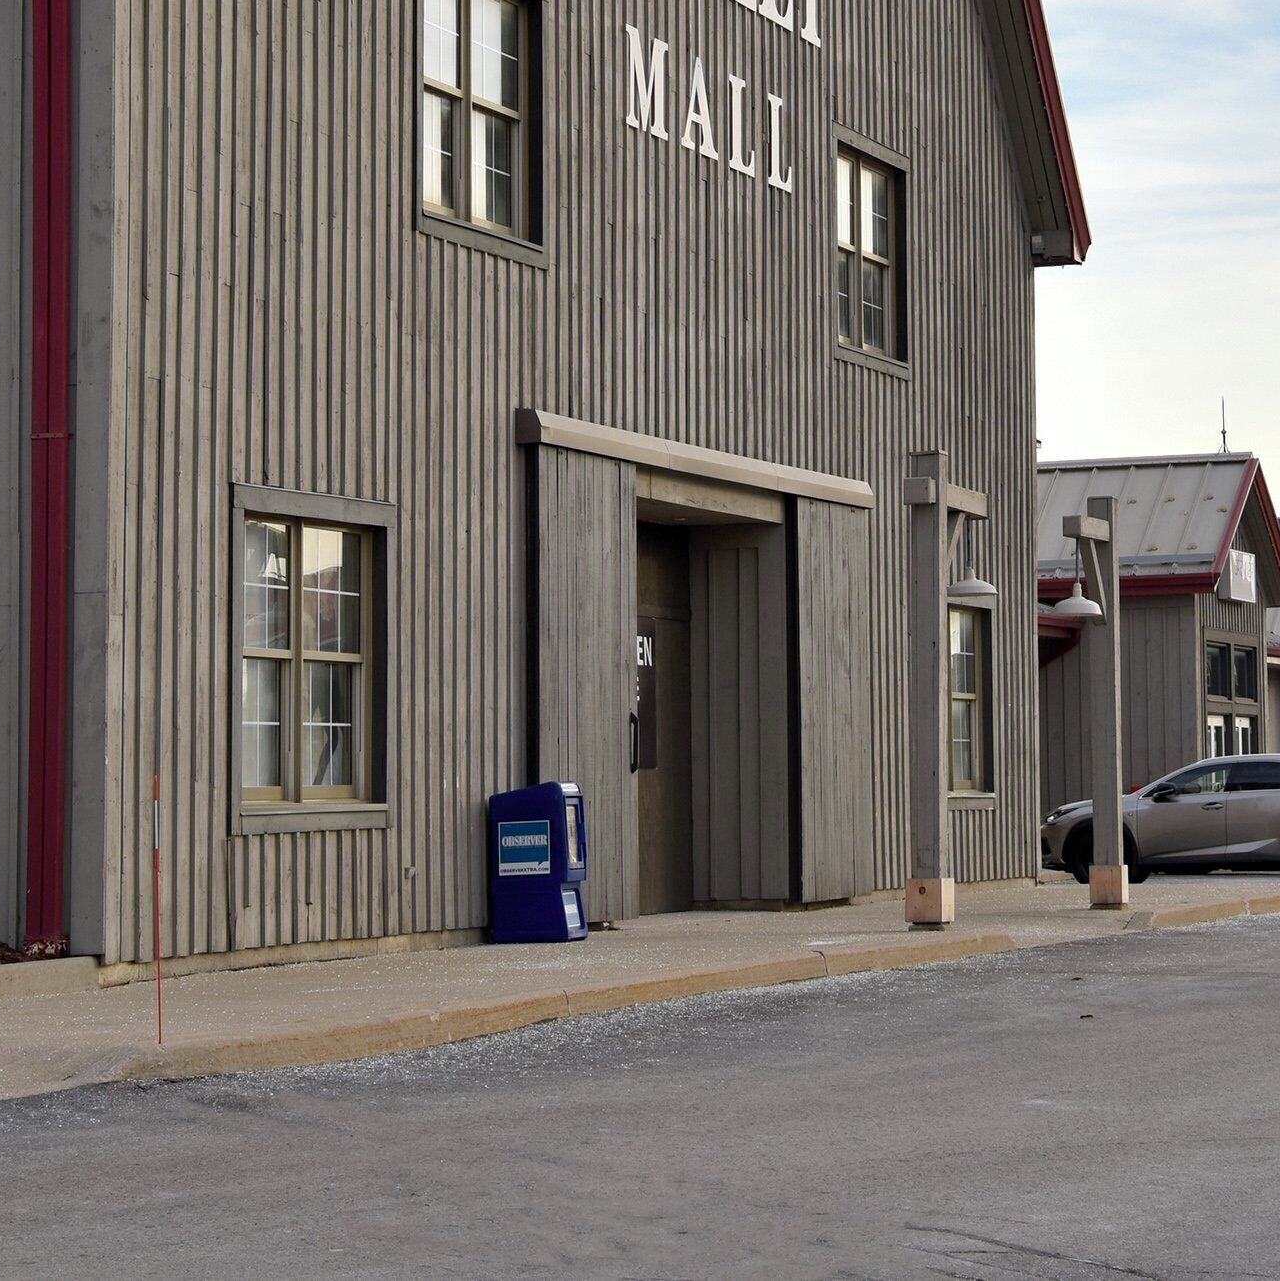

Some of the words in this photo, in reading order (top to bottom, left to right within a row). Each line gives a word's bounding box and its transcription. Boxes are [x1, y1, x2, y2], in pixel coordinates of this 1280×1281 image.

[625, 23, 793, 194] MALL
[636, 634, 653, 667] EN
[501, 834, 549, 847] OBSERVER
